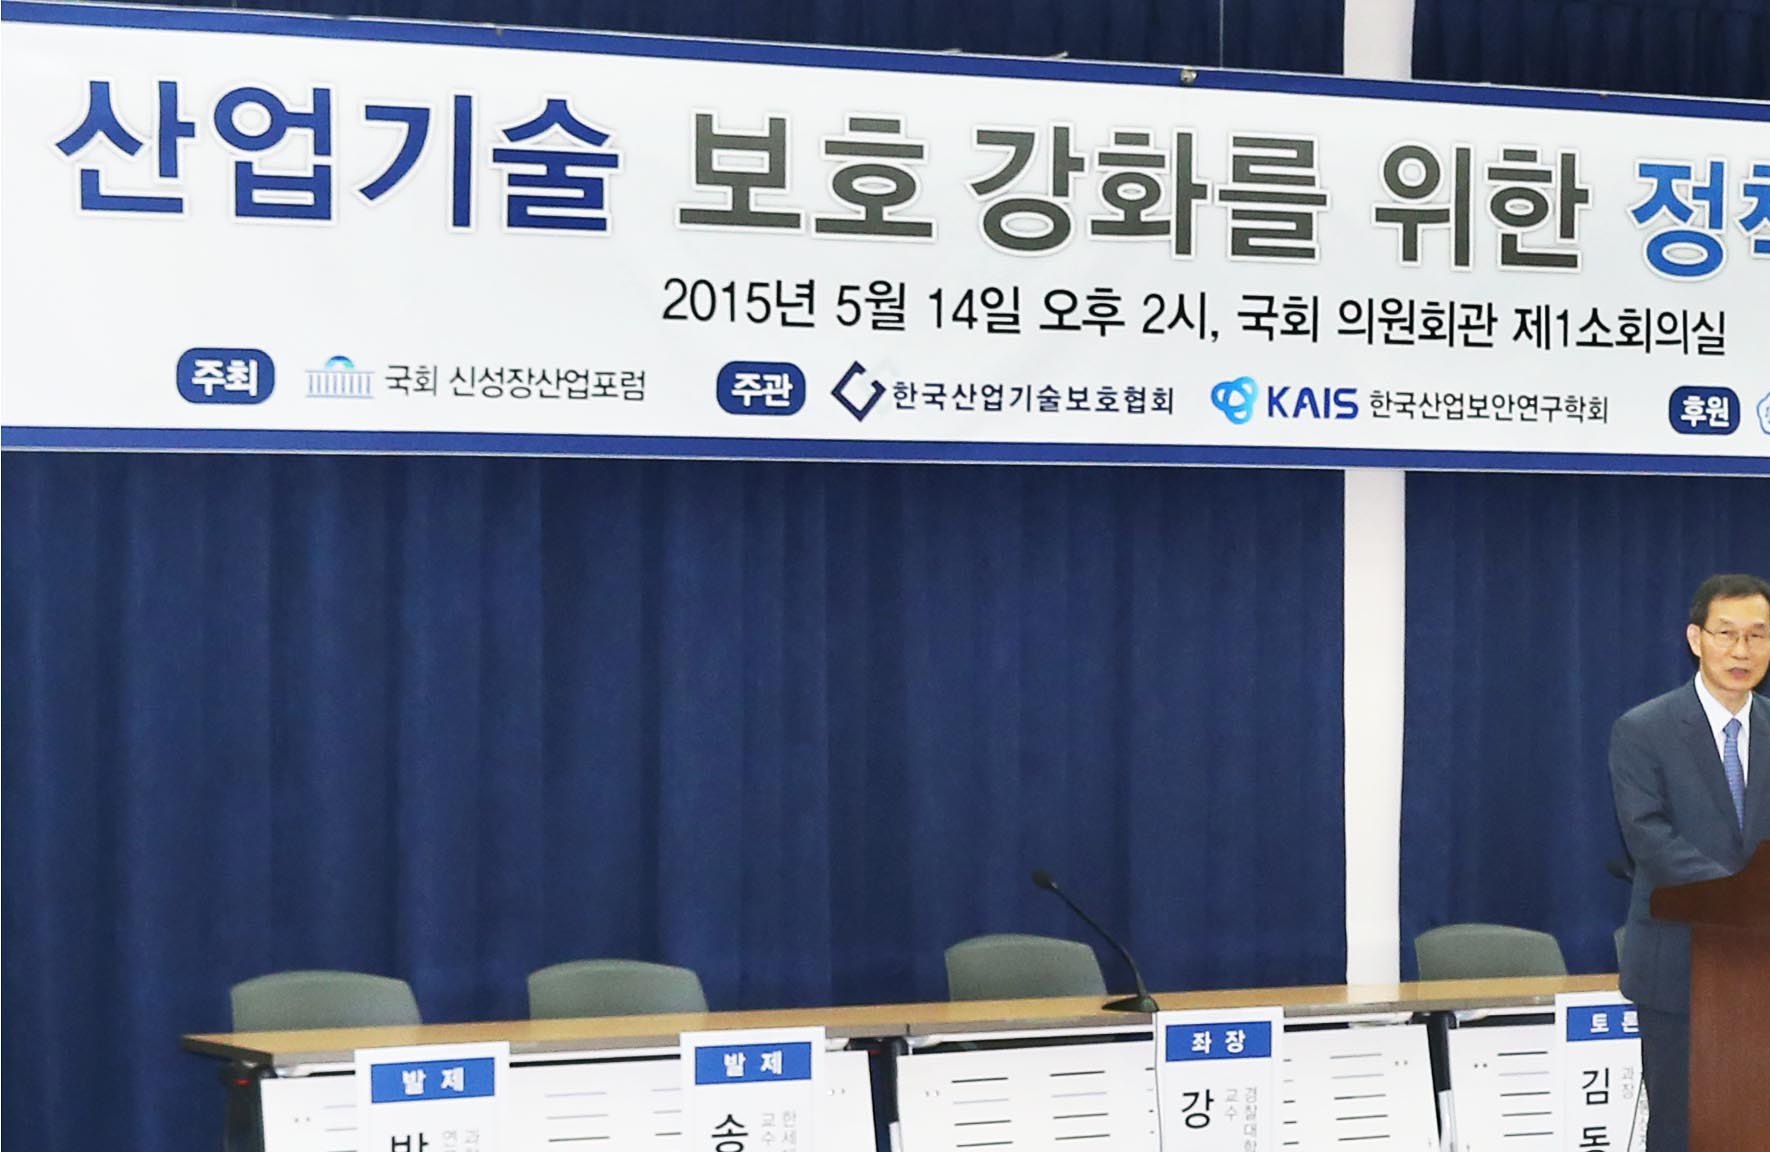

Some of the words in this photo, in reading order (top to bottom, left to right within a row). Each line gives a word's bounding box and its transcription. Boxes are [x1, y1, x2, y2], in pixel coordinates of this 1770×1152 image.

[55, 80, 620, 233] 산업기술
[680, 114, 934, 239] 보호
[970, 124, 1328, 261] 강화를
[1375, 144, 1591, 270] 위한
[662, 277, 815, 328] 2015년
[836, 280, 906, 331] 5월
[928, 285, 1021, 335] 14일
[1039, 287, 1126, 337] 오후
[1142, 291, 1219, 343] 2시,
[1237, 294, 1319, 343] 국회
[1337, 299, 1499, 349] 의원회관
[1512, 306, 1725, 356] 제1소회의실
[191, 360, 259, 397] 주최
[385, 365, 438, 396] 국회
[449, 366, 646, 402] 신성장산업포럼
[732, 374, 794, 408] 주관
[892, 381, 1174, 416] 한국산업기술보호협회
[1267, 385, 1359, 420] KAIS
[1369, 389, 1608, 425] 한국산업보안연구학회
[1681, 396, 1731, 428] 후원
[1181, 1087, 1216, 1130] 강
[760, 1112, 777, 1147] 교수
